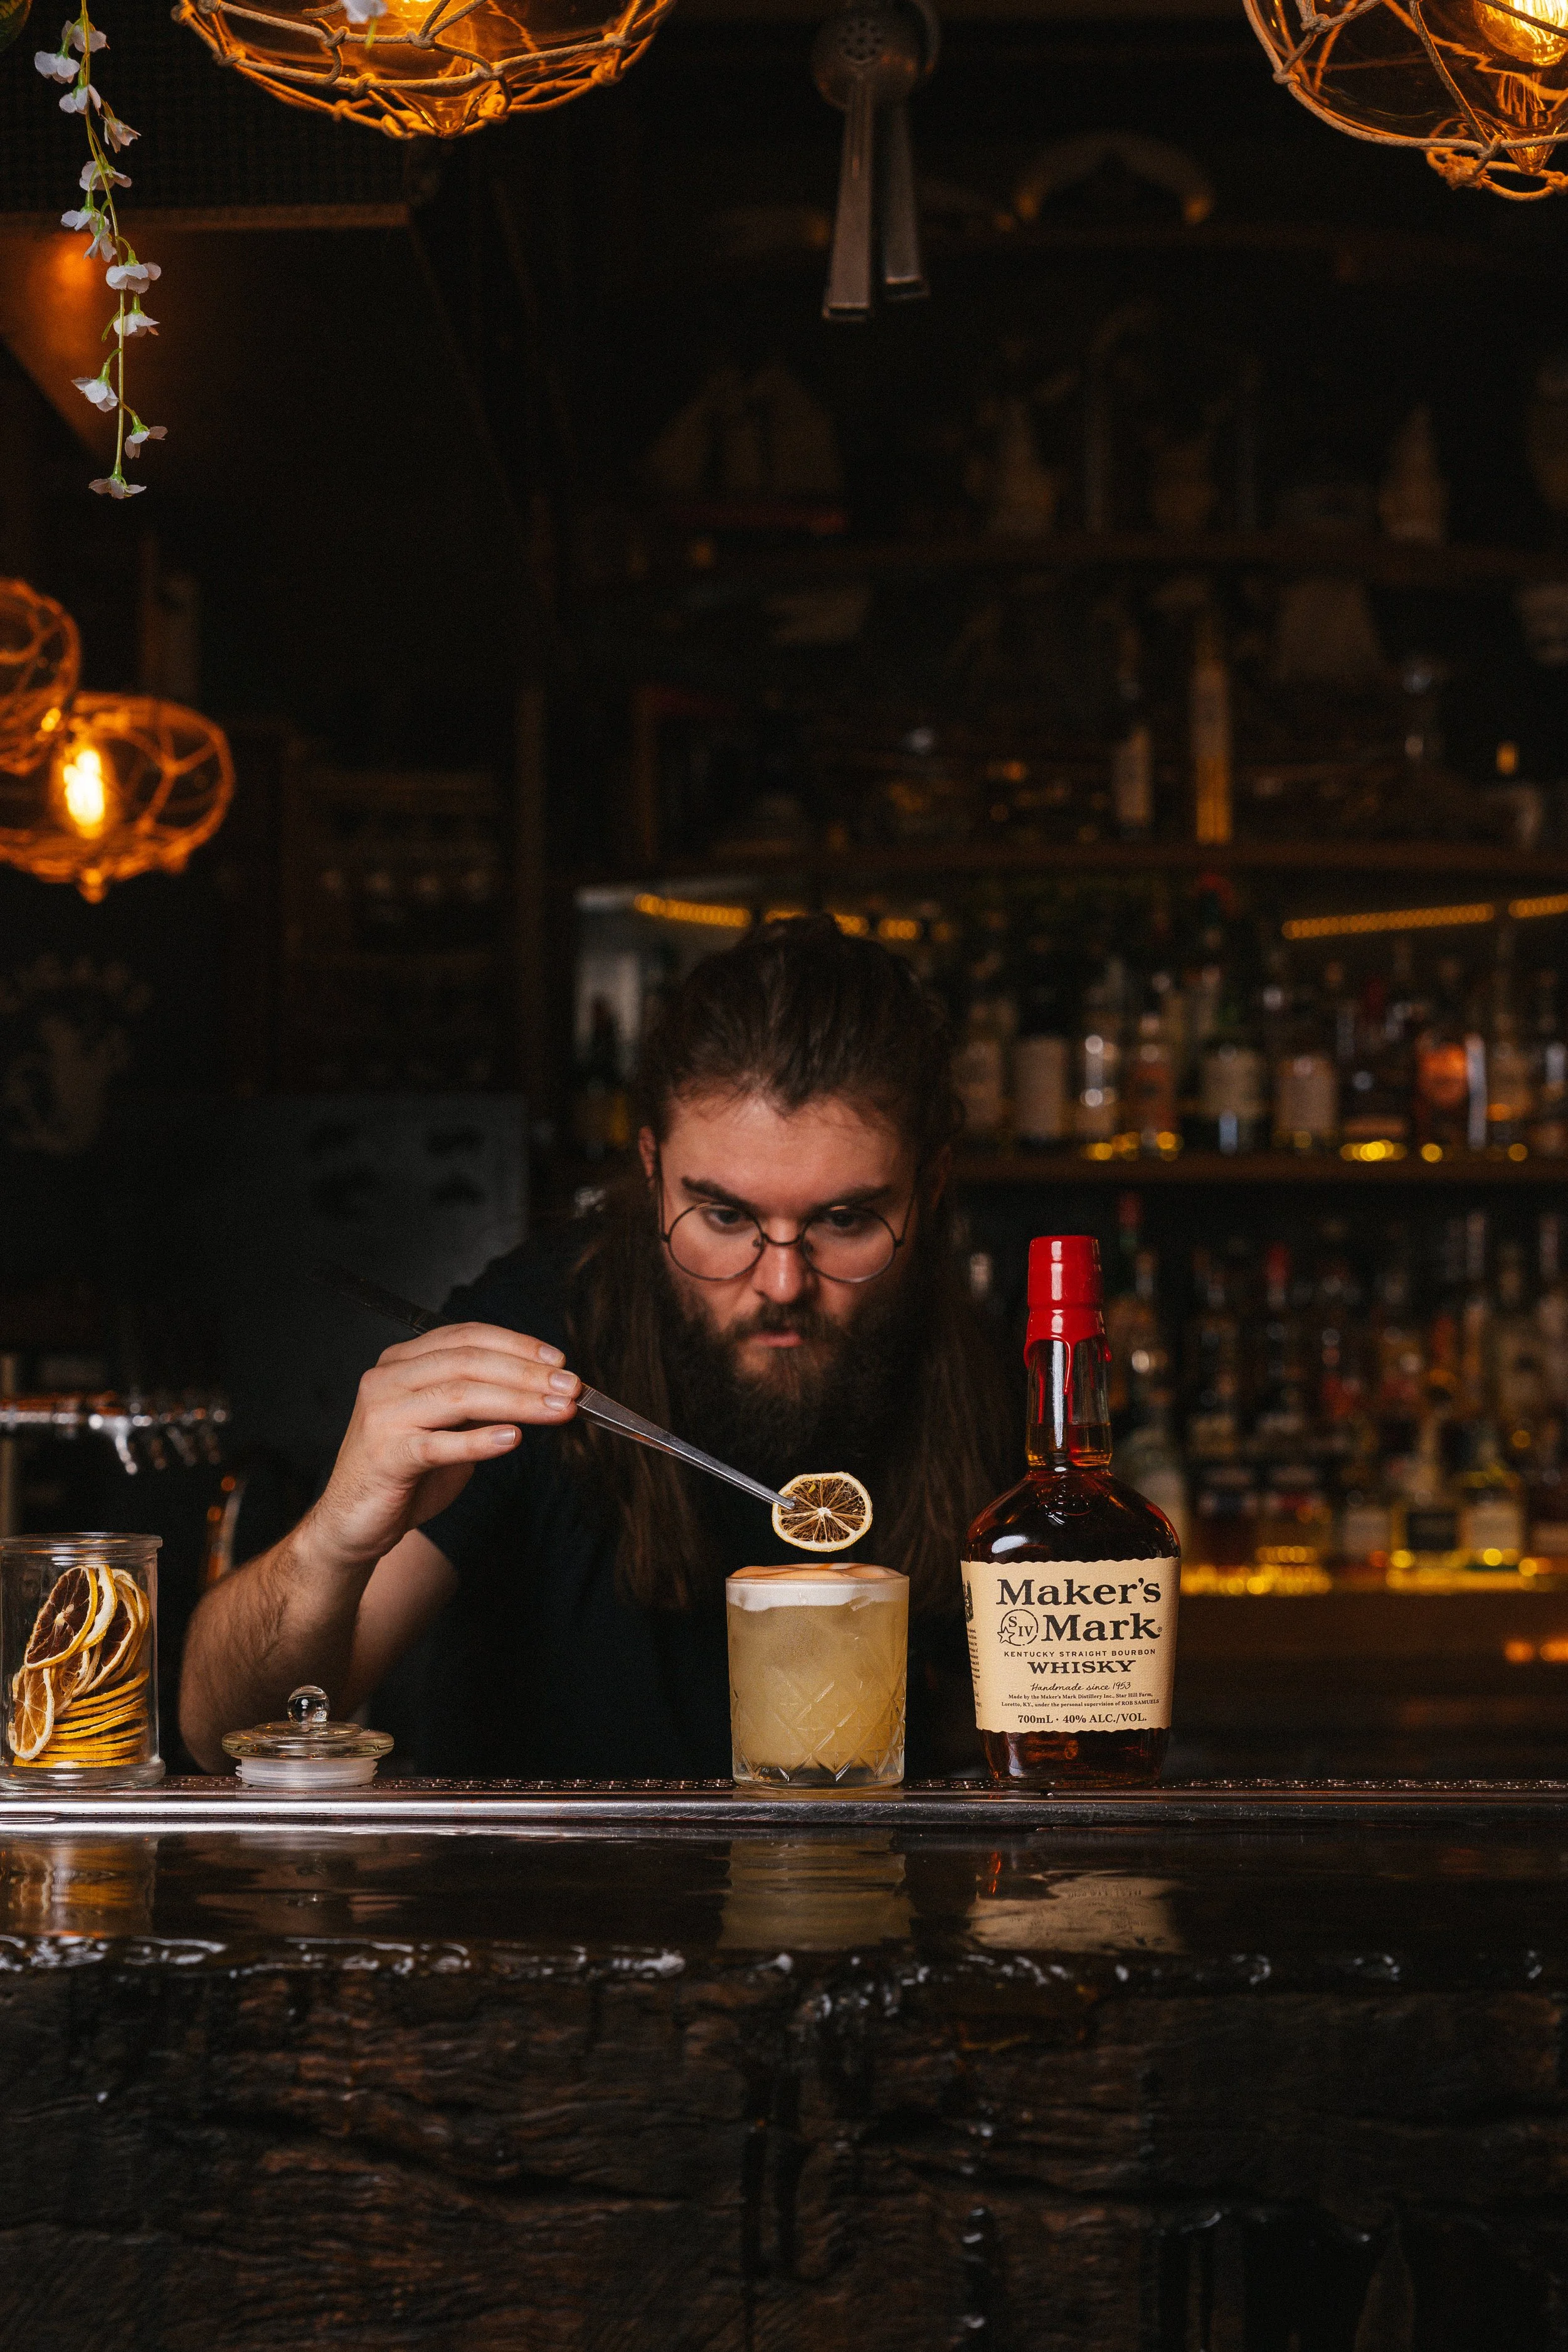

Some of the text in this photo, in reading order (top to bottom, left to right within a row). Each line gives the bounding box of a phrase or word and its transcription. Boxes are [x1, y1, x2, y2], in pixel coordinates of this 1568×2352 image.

[996, 1577, 1162, 1606] Maker's
[1111, 1648, 1156, 1656] BOURBON
[1027, 1660, 1136, 1674] WHISKY
[1030, 1683, 1084, 1692] Handmade
[1112, 1681, 1131, 1690] 1953
[1018, 1713, 1147, 1724] 700mL 40% ALC./VOL.
